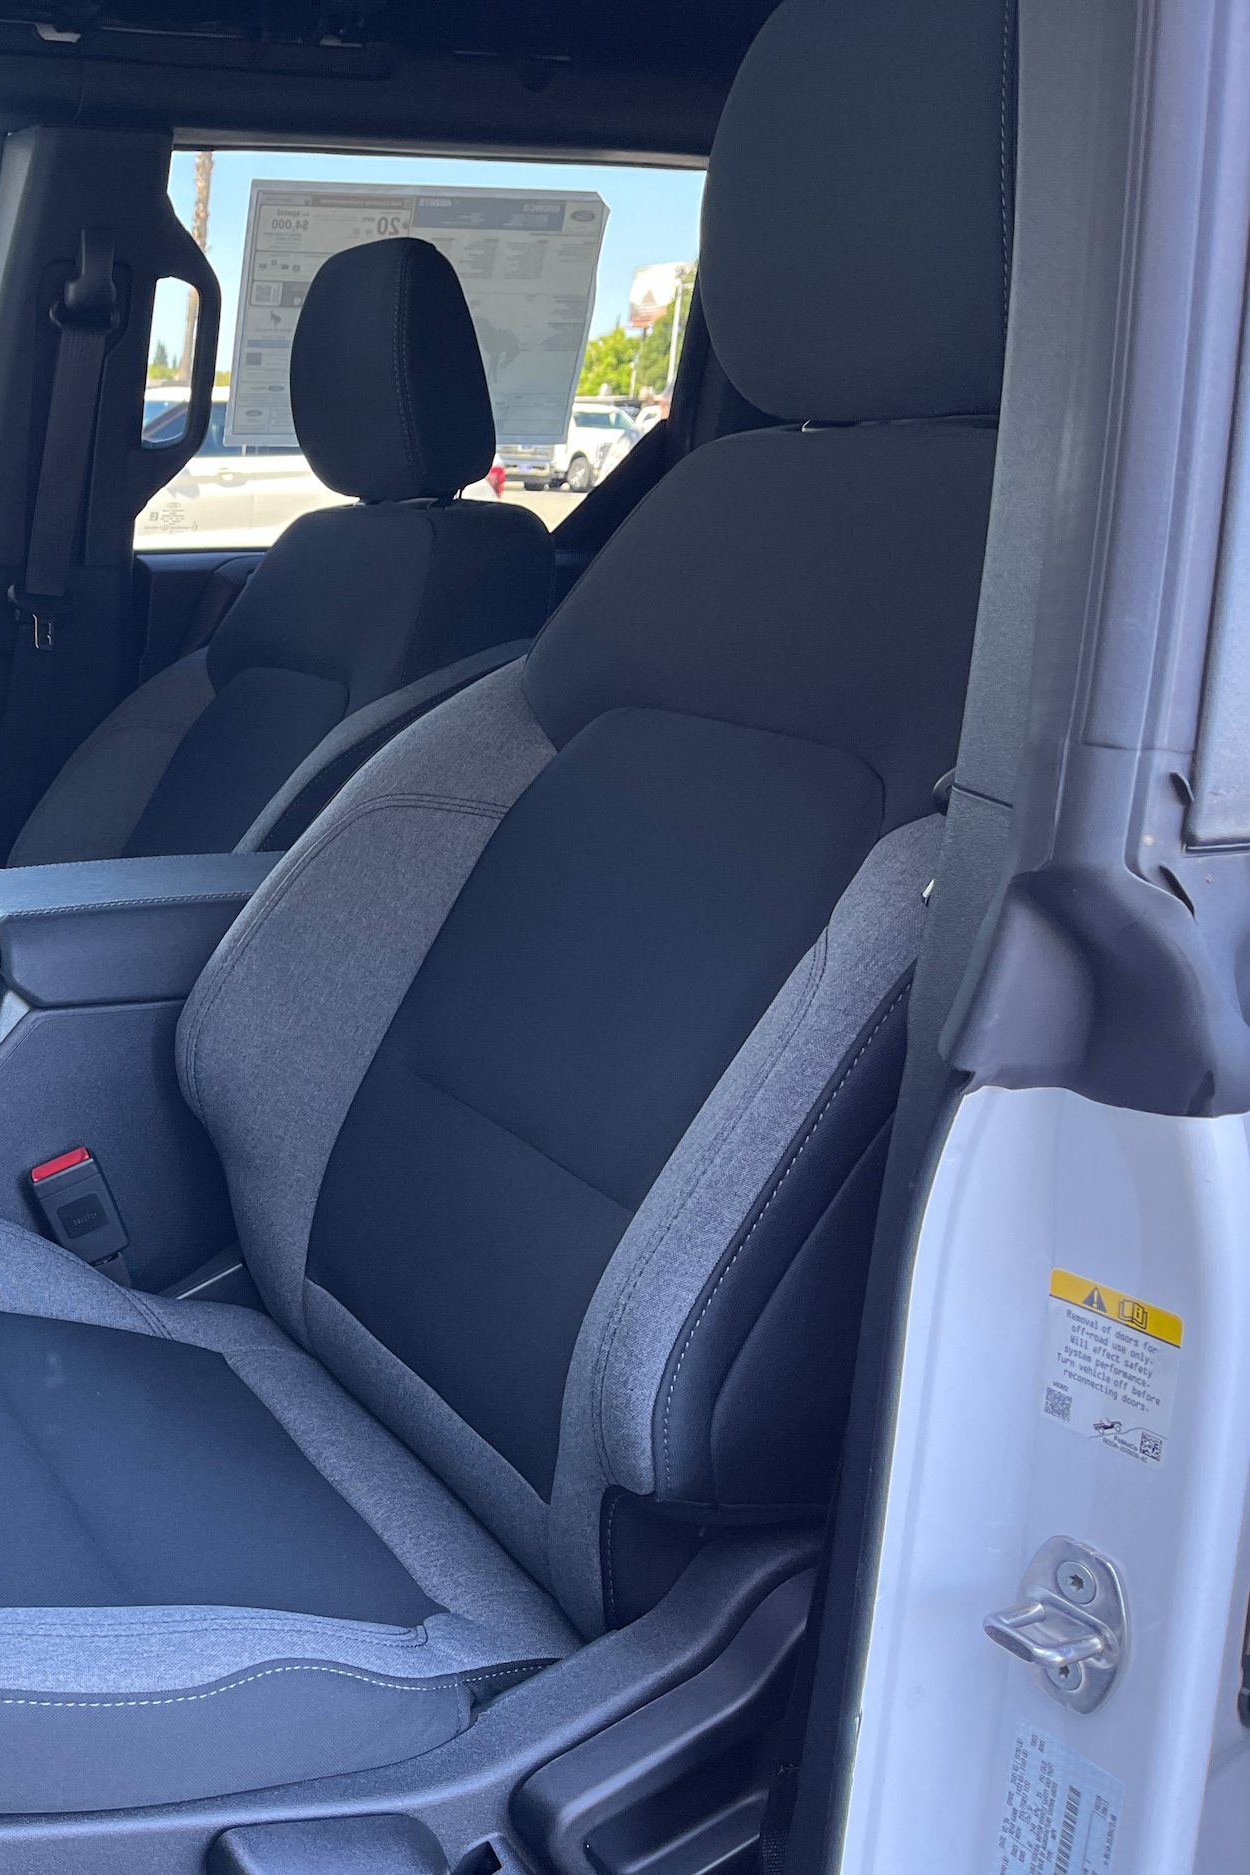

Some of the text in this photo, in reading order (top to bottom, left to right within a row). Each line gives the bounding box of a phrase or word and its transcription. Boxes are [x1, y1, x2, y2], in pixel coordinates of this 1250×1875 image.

[1066, 1309, 1158, 1354] Removal of doors for
[1071, 1324, 1109, 1346] off-road
[1112, 1342, 1127, 1354] use
[1064, 1345, 1092, 1362] system
[1070, 1335, 1153, 1379] Will affect safety
[1056, 1352, 1161, 1406] Turn vehicle off before
[1063, 1369, 1118, 1401] reconnecting
